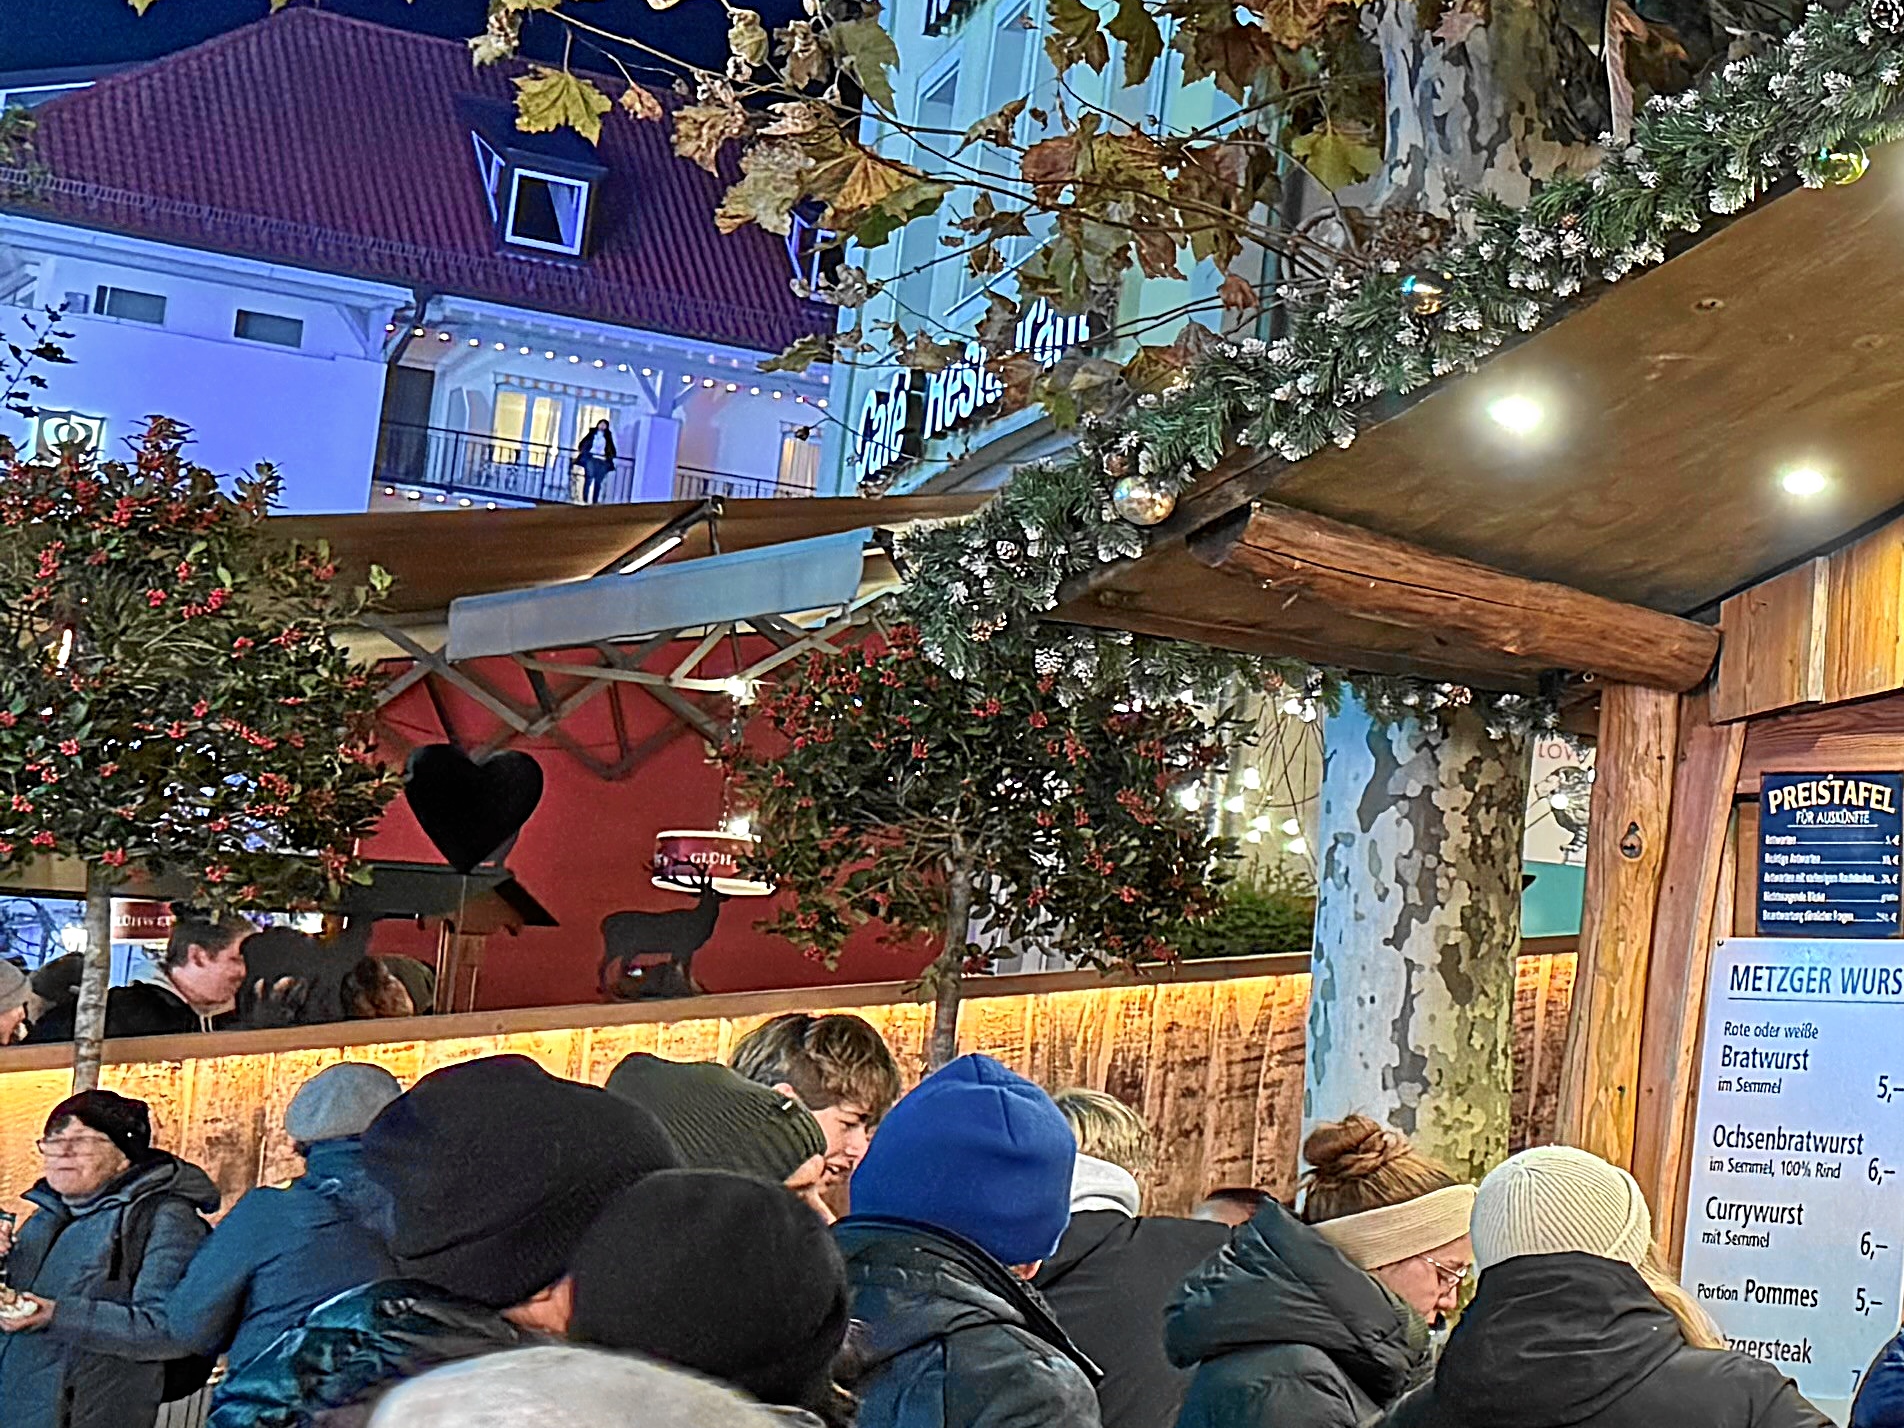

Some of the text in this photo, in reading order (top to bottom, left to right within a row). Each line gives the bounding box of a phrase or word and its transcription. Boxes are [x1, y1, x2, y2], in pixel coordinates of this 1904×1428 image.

[1768, 780, 1896, 815] PREISTAFEL
[1730, 965, 1832, 994] METZGER
[1724, 1021, 1819, 1039] Rote oder weiße
[1721, 1044, 1809, 1071] Bratwurst
[1718, 1076, 1732, 1092] im
[1736, 1077, 1782, 1094] Semmel
[1713, 1124, 1864, 1155] Ochsenbratwurst
[1709, 1156, 1724, 1172] im
[1728, 1157, 1775, 1177] Semmel,
[1815, 1162, 1842, 1179] Rind
[1705, 1196, 1804, 1228] Currywurst
[1702, 1229, 1721, 1245] mit
[1725, 1230, 1770, 1248] Semmel
[1697, 1283, 1738, 1301] Portion
[1744, 1279, 1819, 1308] Pommes
